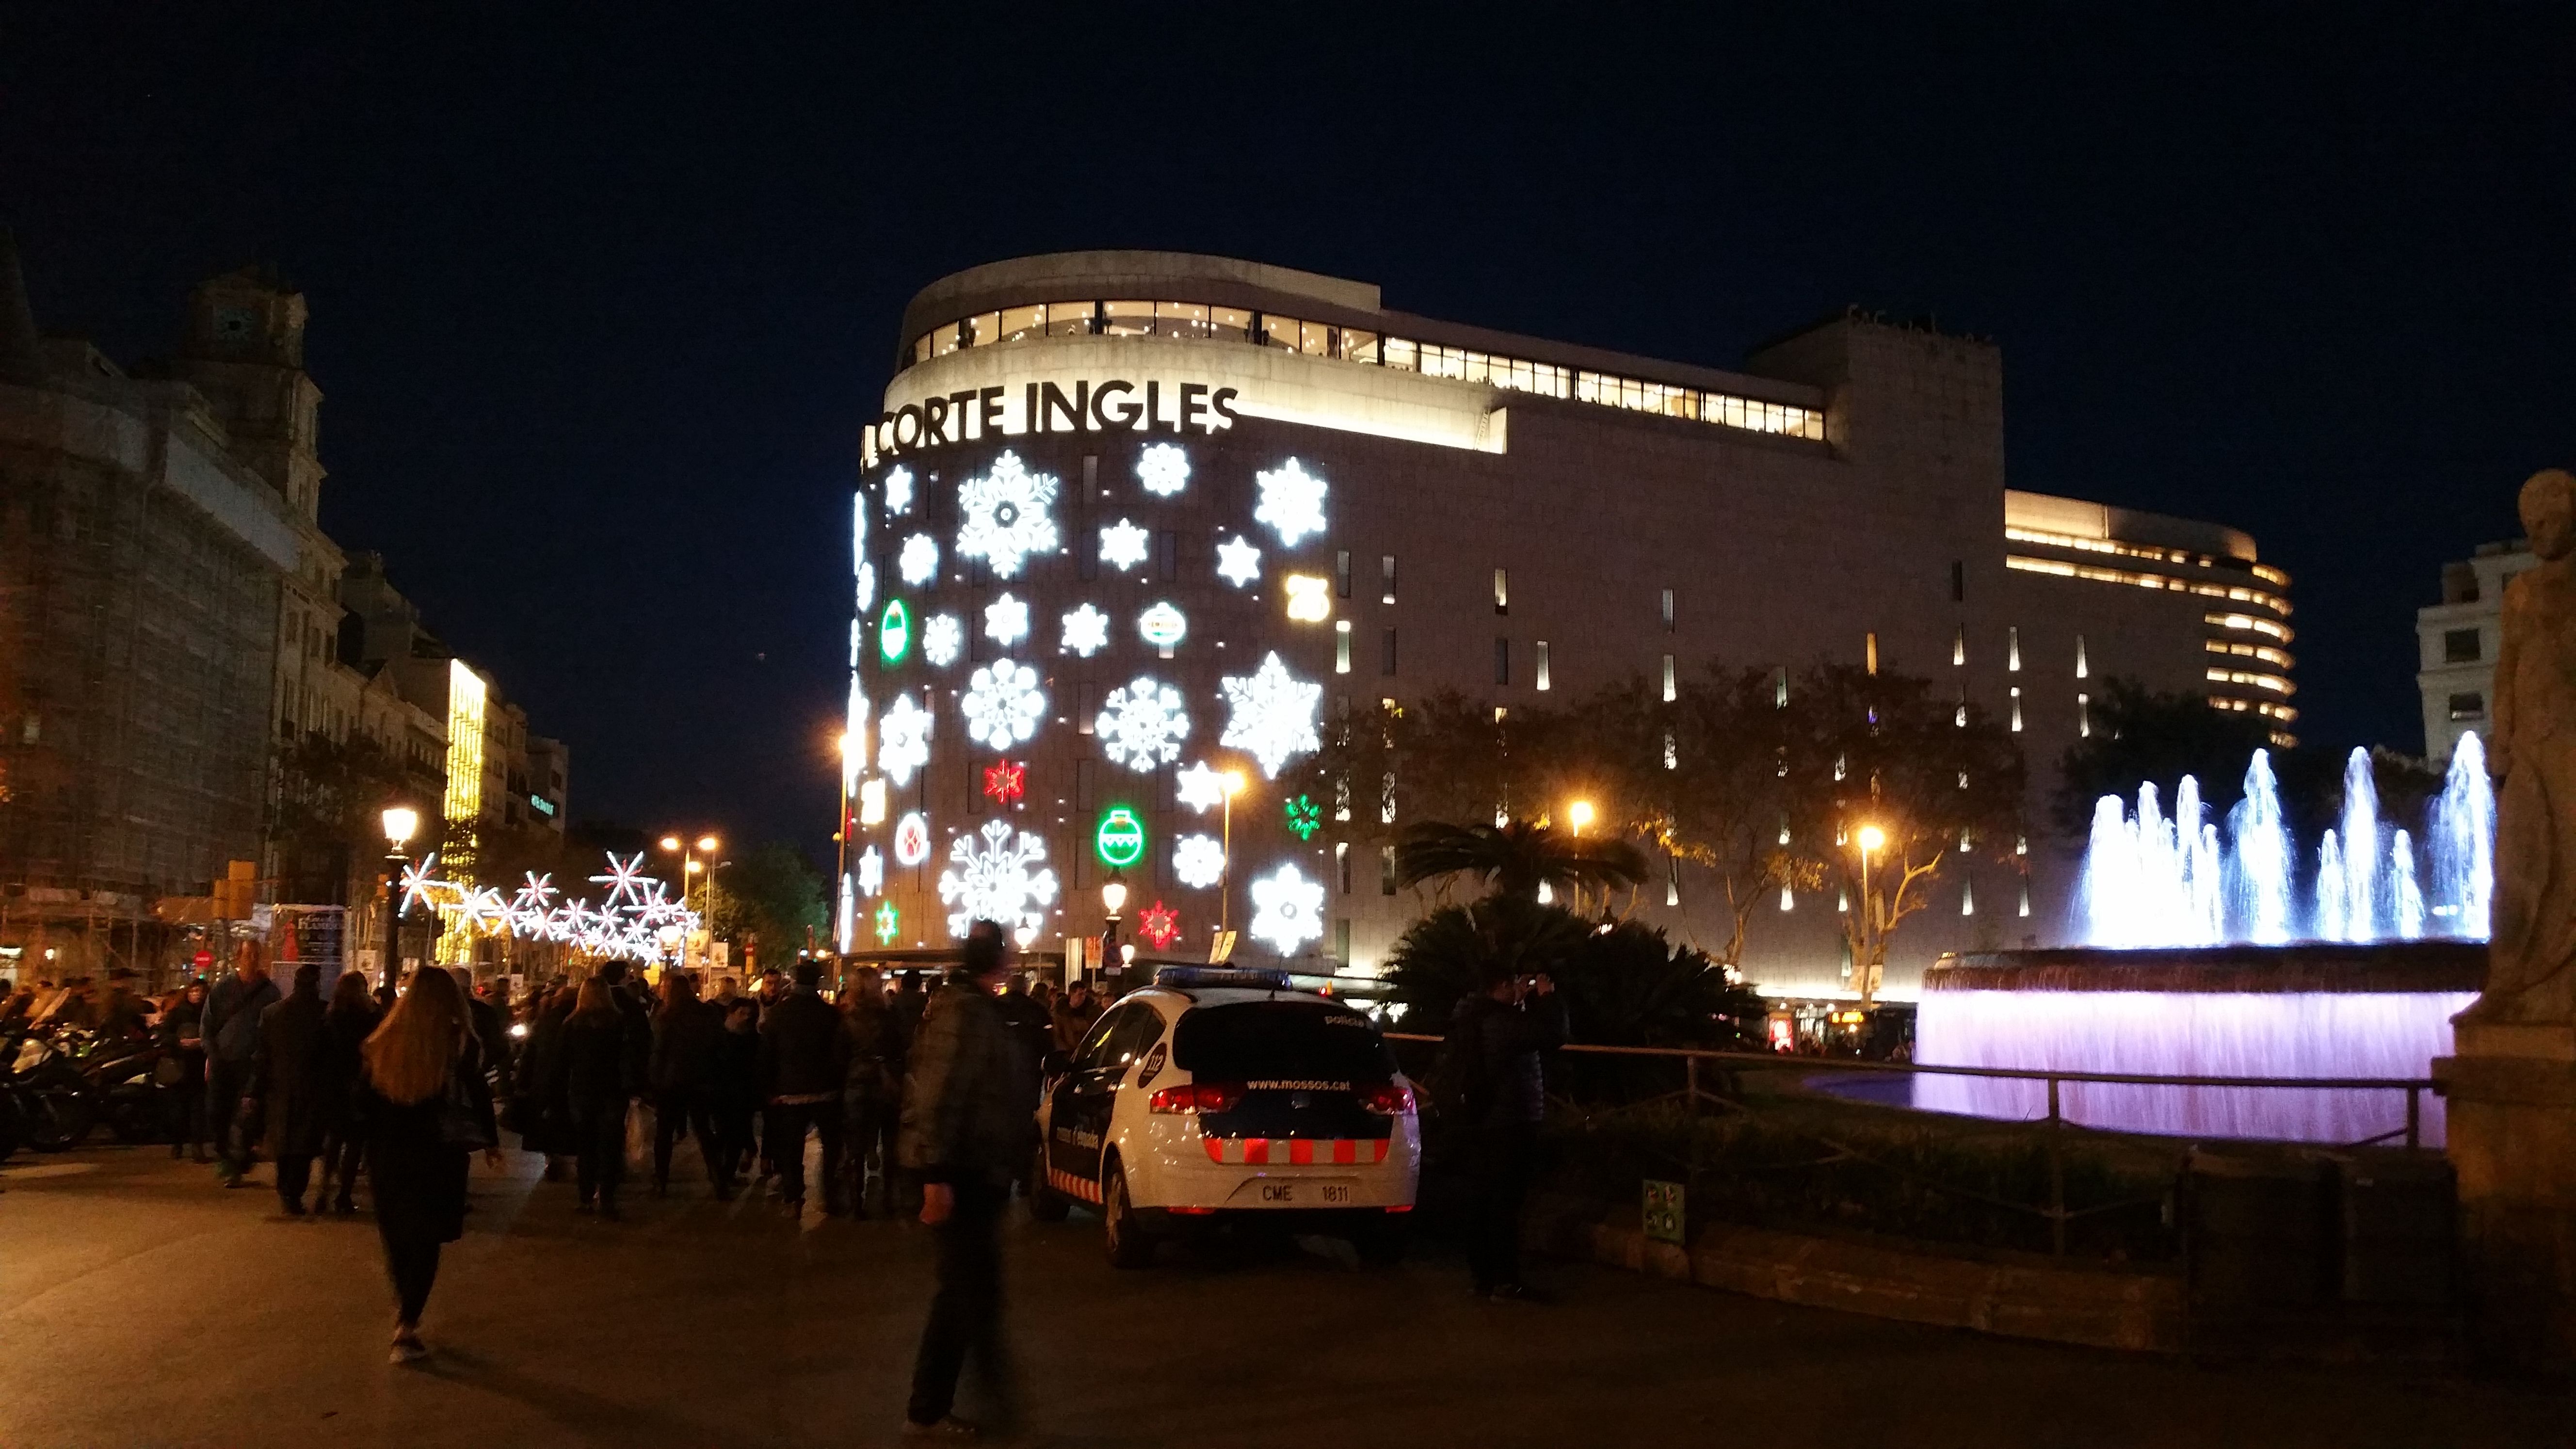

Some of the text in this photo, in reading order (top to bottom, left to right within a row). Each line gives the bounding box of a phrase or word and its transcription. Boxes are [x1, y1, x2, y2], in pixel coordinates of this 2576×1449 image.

[875, 385, 1004, 455] CORTE
[1026, 380, 1238, 435] INGLES
[1147, 1054, 1164, 1072] 112
[1246, 1079, 1351, 1091] www.mossos.cat
[1263, 1185, 1348, 1202] CME 1811
